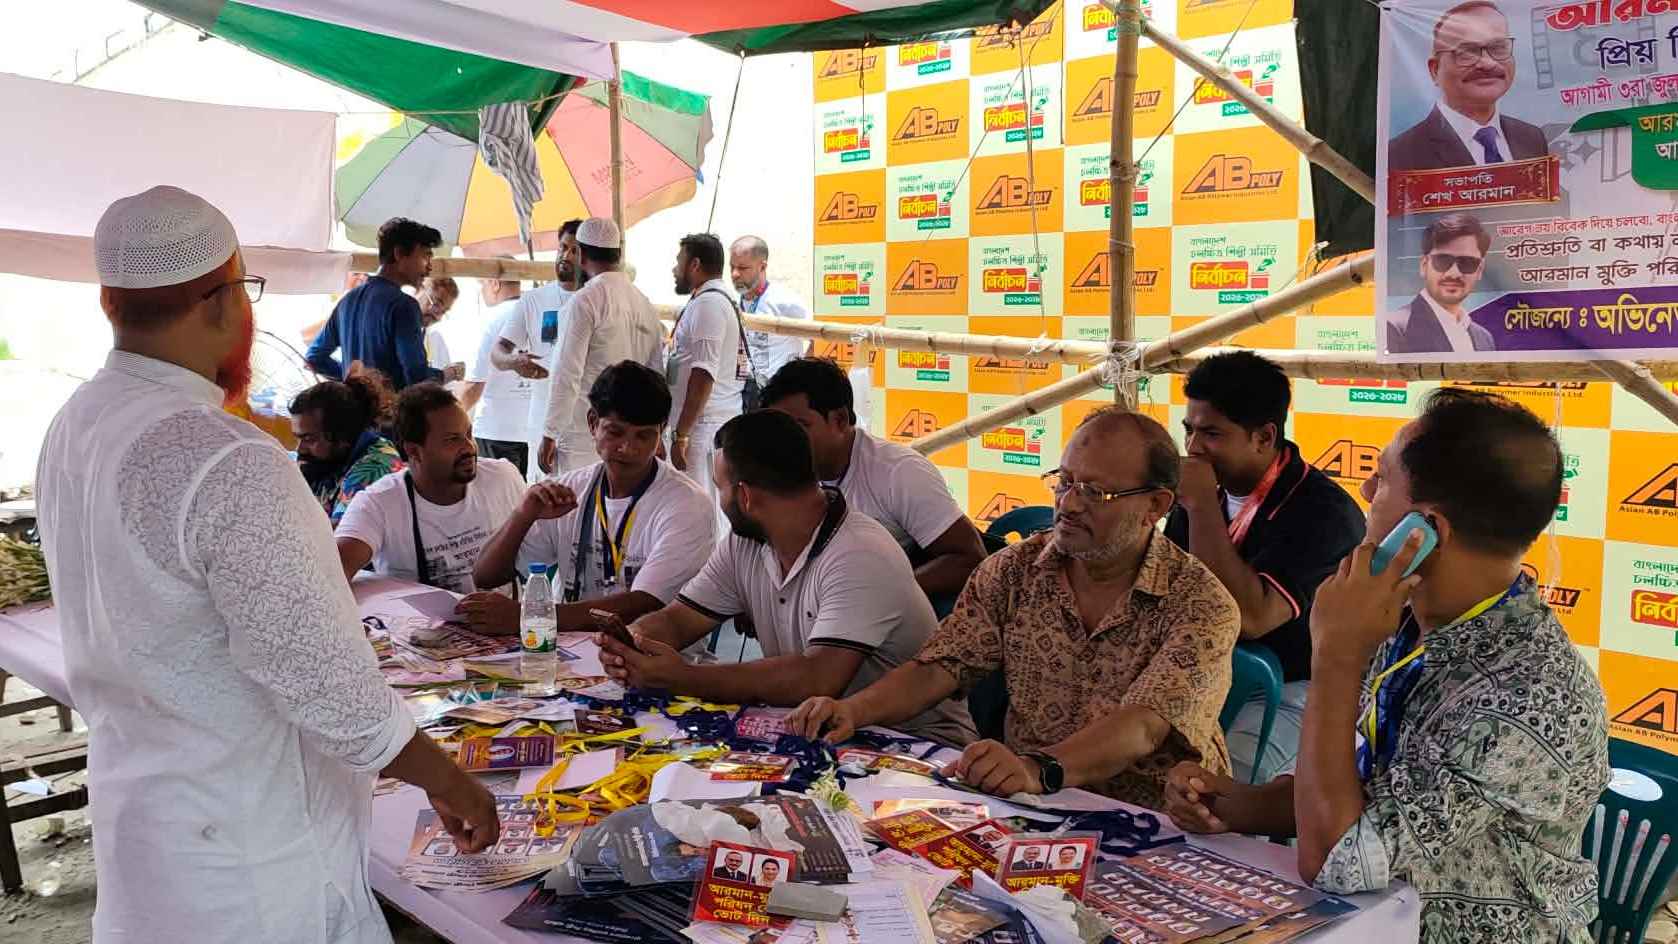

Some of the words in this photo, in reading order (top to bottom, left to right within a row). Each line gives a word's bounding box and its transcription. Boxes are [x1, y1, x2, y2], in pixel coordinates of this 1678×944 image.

[1595, 37, 1658, 70] প্রিয়
[892, 107, 939, 140] AB
[1181, 154, 1252, 194] AB
[819, 192, 859, 222] AB
[976, 175, 1028, 209] AB
[1423, 192, 1452, 205] শেখ
[1459, 186, 1515, 201] আরমান
[1588, 239, 1606, 252] বা
[1613, 233, 1664, 250] কথায়
[892, 260, 938, 291] AB
[1520, 267, 1590, 282] আরমান
[1595, 260, 1639, 285] মুক্তি
[1504, 302, 1573, 330] সৌজন্যে
[892, 409, 940, 439] AB
